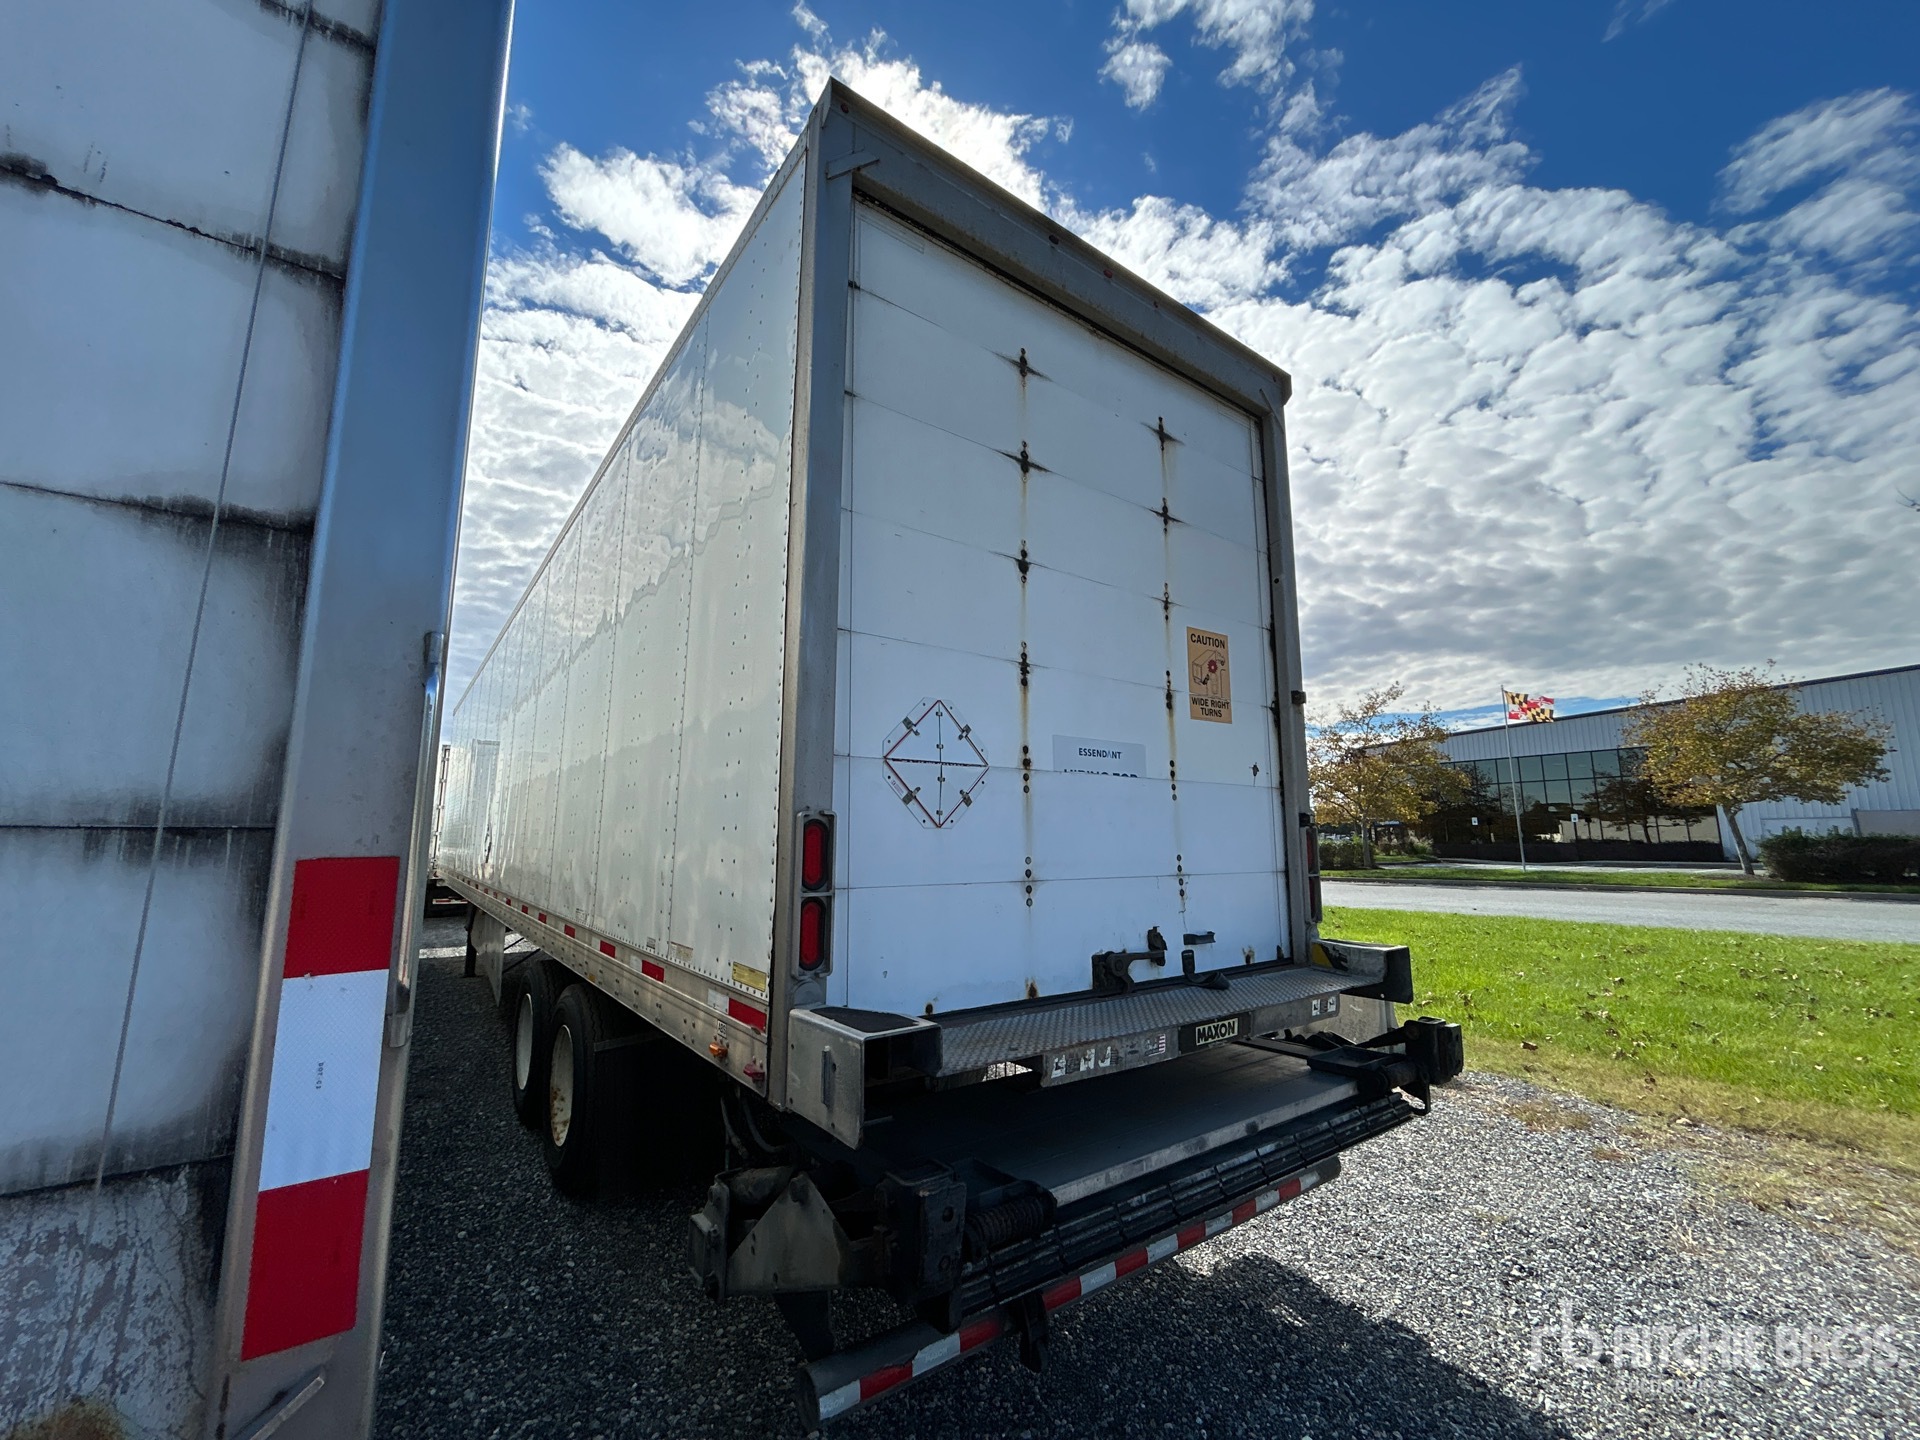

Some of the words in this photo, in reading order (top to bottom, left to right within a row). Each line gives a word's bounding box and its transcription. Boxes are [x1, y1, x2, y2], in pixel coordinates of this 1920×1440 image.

[1190, 633, 1226, 650] CAUTION
[1191, 697, 1210, 707] WIDE
[1210, 699, 1231, 710] RIGHT
[1200, 707, 1223, 718] TURNS
[1078, 747, 1122, 760] ESSENDANT
[1197, 1020, 1235, 1043] MAXON
